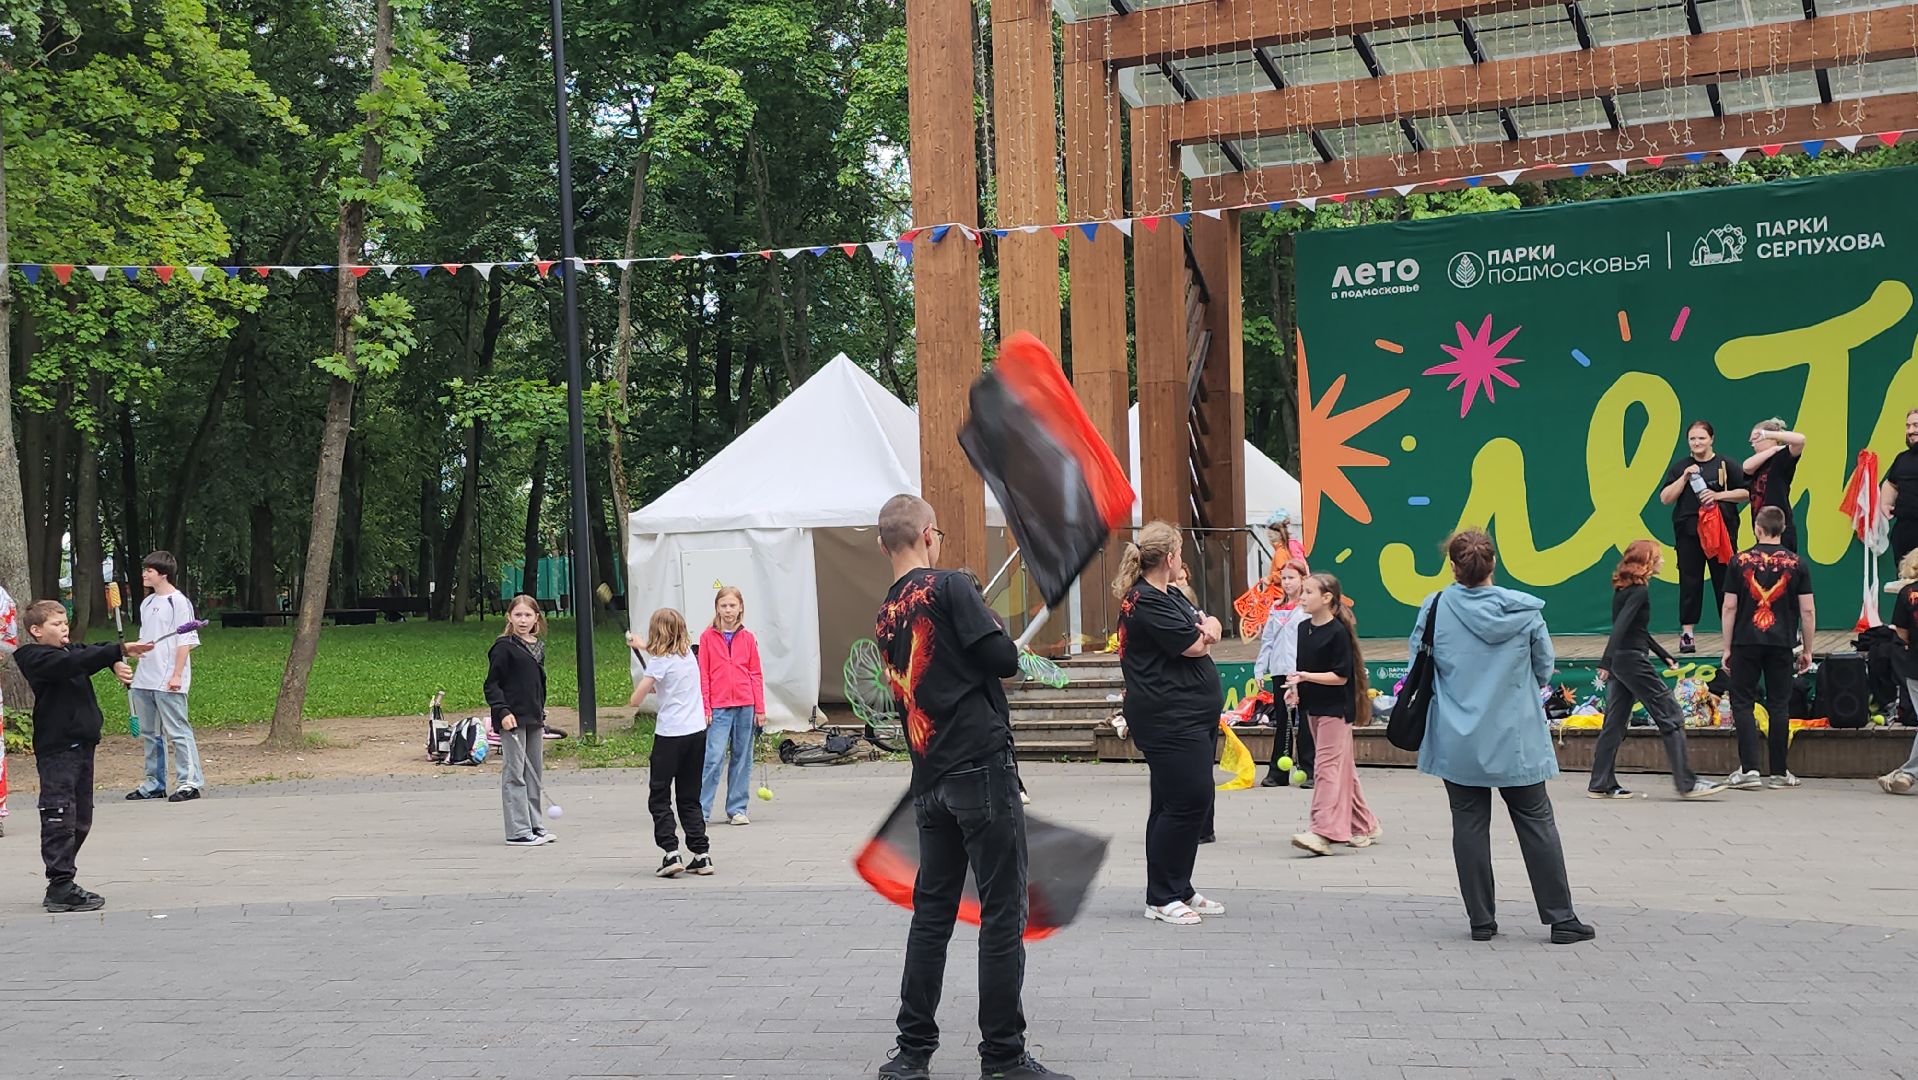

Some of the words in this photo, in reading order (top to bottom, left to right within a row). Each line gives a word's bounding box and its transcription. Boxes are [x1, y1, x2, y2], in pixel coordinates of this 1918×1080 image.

[1756, 215, 1828, 238] ПАРКИ
[1487, 244, 1555, 265] ПАРКИ
[1756, 232, 1886, 259] СЕРПУХОВА
[1488, 254, 1650, 285] ПОДМОСКОВЬЯ
